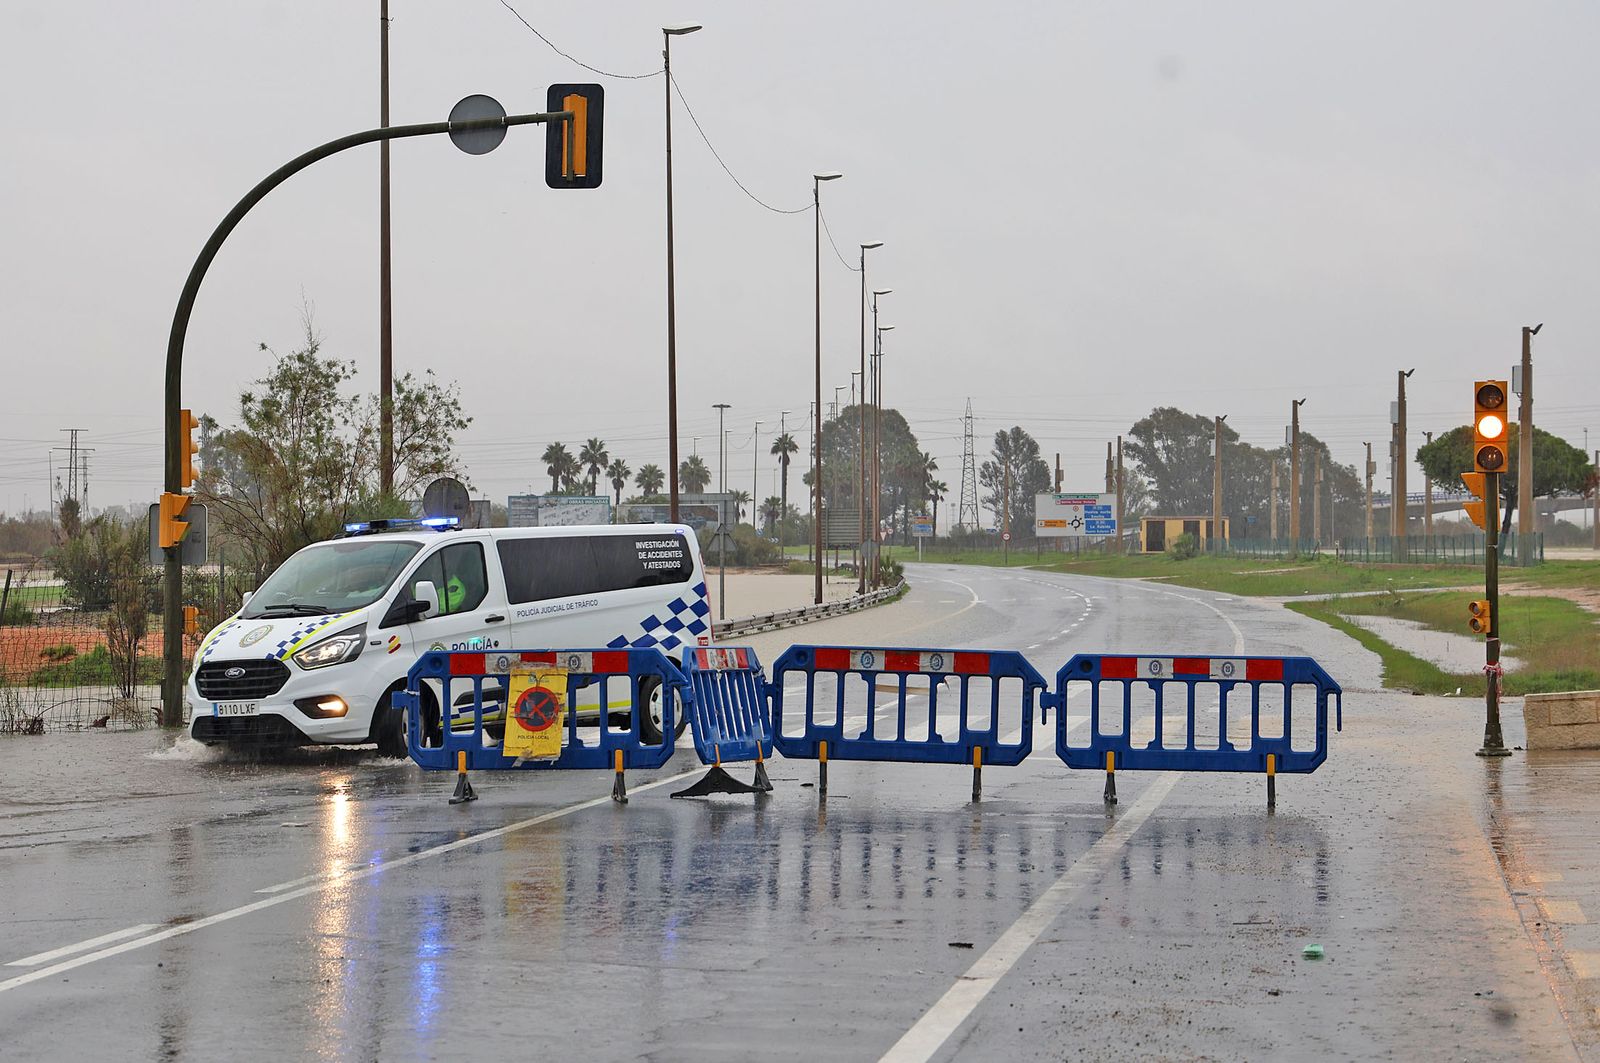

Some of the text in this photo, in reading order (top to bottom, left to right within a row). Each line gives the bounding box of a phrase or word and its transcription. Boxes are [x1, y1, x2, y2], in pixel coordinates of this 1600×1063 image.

[636, 539, 679, 548] INVESTIGACIÓN
[648, 550, 683, 559] ACCIDENTES
[648, 561, 681, 569] ATESTADOS
[541, 604, 565, 614] JUDICIAL
[219, 704, 255, 715] 8110 LXF
